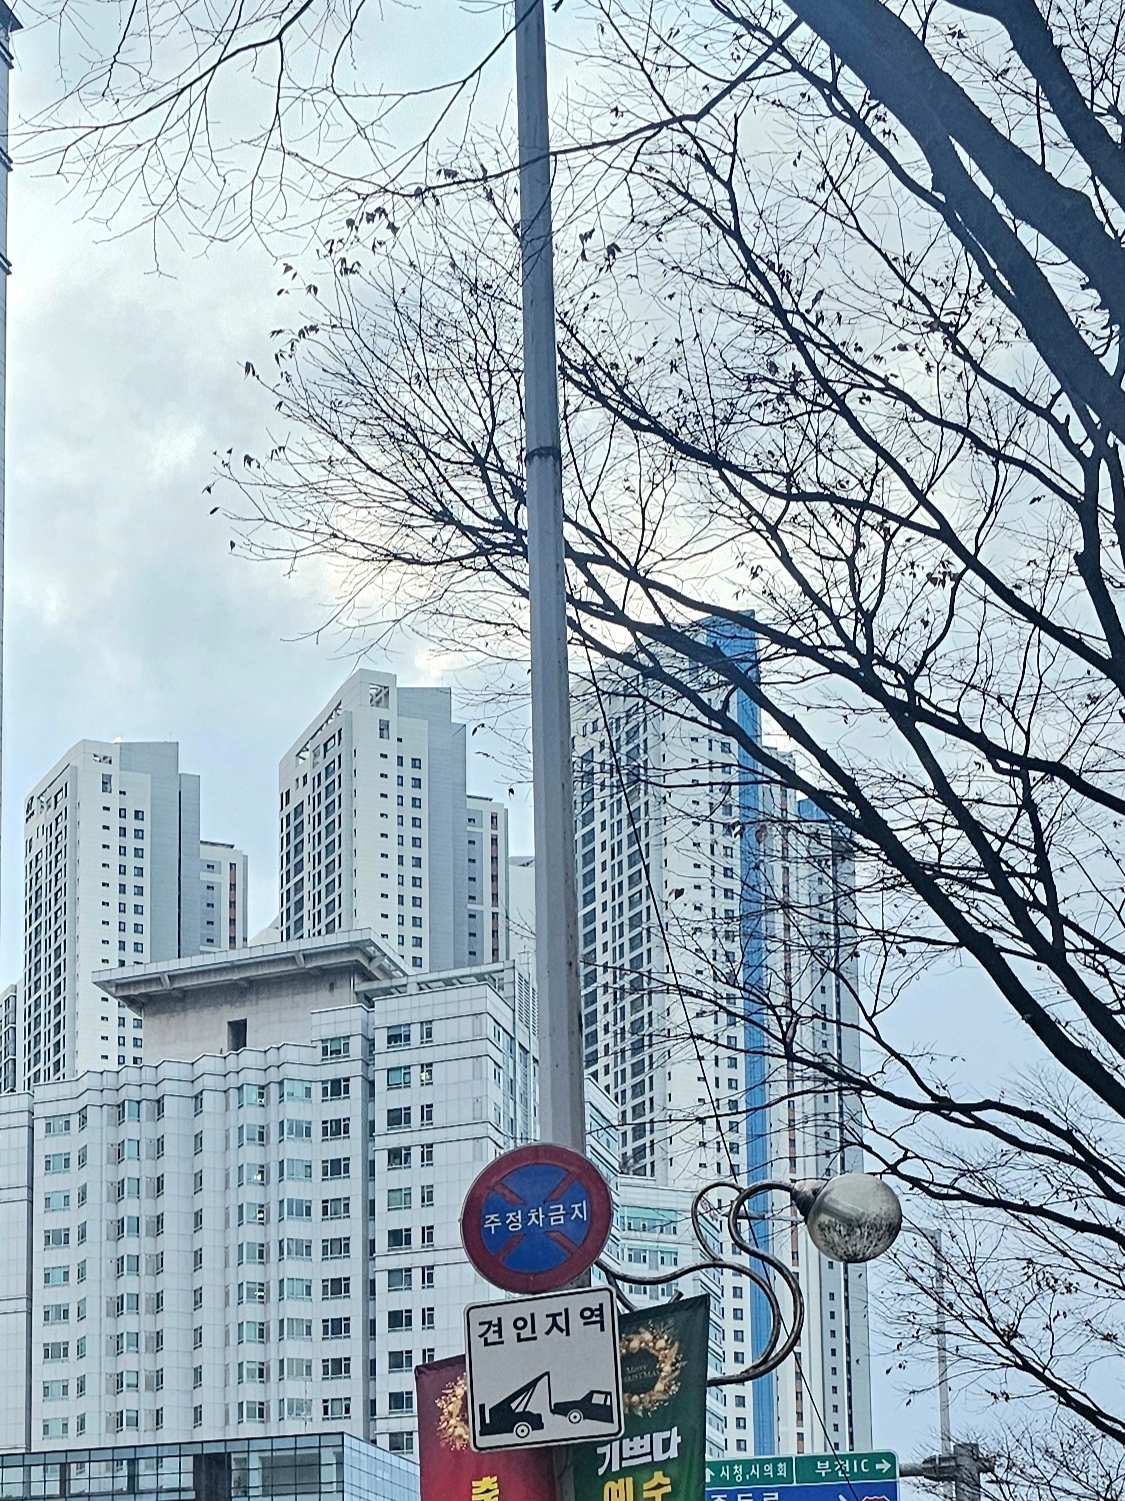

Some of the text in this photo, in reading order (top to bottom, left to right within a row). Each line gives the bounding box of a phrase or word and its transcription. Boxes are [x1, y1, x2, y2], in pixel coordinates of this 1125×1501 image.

[483, 1200, 588, 1234] 주정차금지
[478, 1303, 606, 1347] 견인지역
[597, 1427, 681, 1475] 기쁘다
[815, 1459, 870, 1477] 부천IC
[720, 1461, 788, 1480] 시청,시의회
